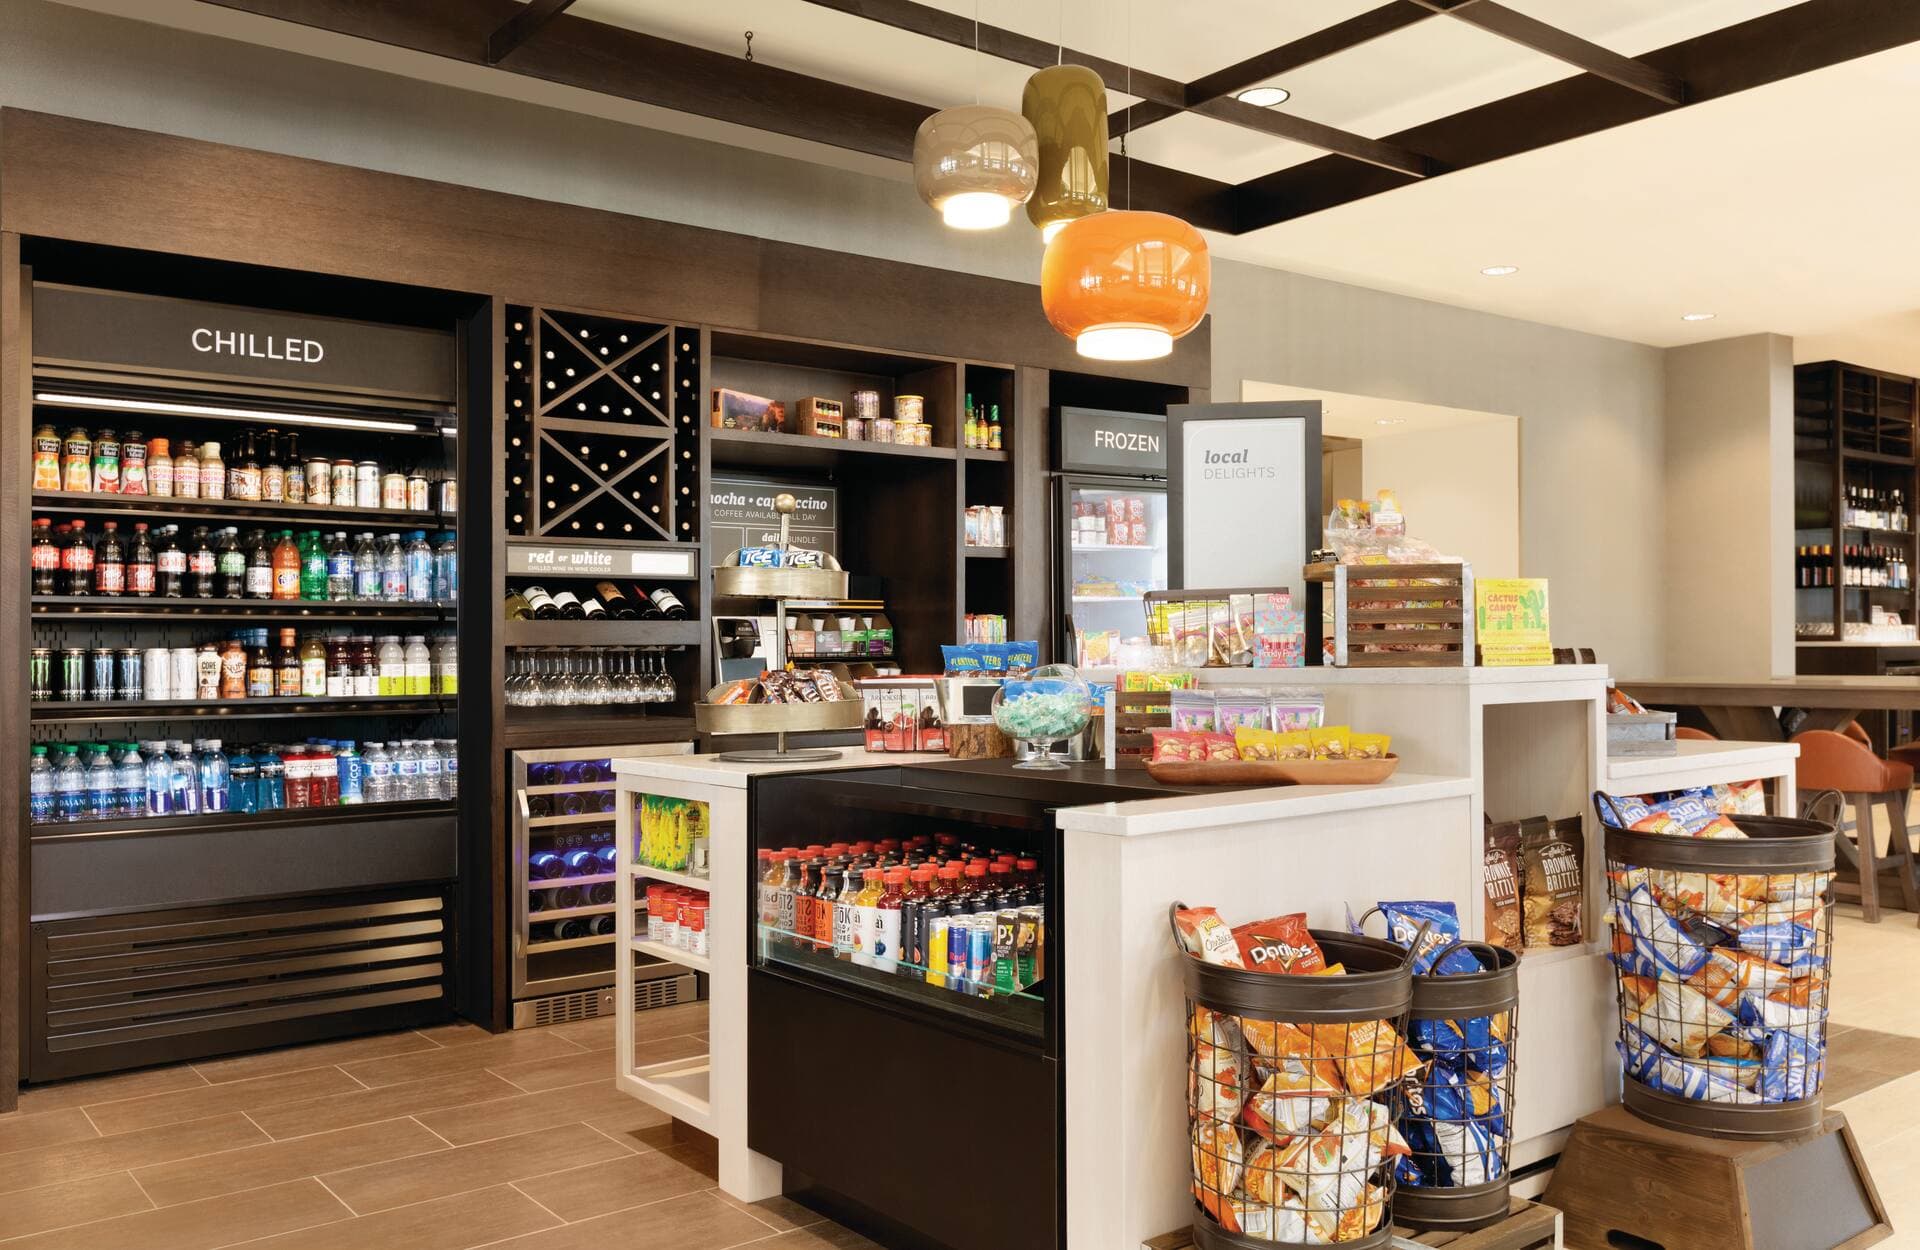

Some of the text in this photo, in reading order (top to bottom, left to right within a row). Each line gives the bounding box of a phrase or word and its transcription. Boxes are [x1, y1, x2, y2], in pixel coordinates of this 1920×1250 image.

[191, 328, 324, 363] CHILLED
[1095, 430, 1160, 453] FROZEN
[1204, 449, 1248, 465] local
[1204, 466, 1275, 480] DELIGHTS
[756, 496, 828, 510] capccino
[714, 509, 743, 518] COFFEE
[745, 511, 780, 520] AVAILABL
[761, 532, 780, 542] dail
[528, 550, 555, 564] red
[571, 551, 612, 565] white
[1488, 594, 1519, 602] CACTUS
[201, 661, 216, 669] CORE
[1484, 861, 1513, 882] ROWNIE
[1542, 854, 1578, 876] BROWNIE
[1546, 870, 1580, 892] BRITTLE
[997, 924, 1014, 945] P3
[1251, 944, 1313, 964] Doritos
